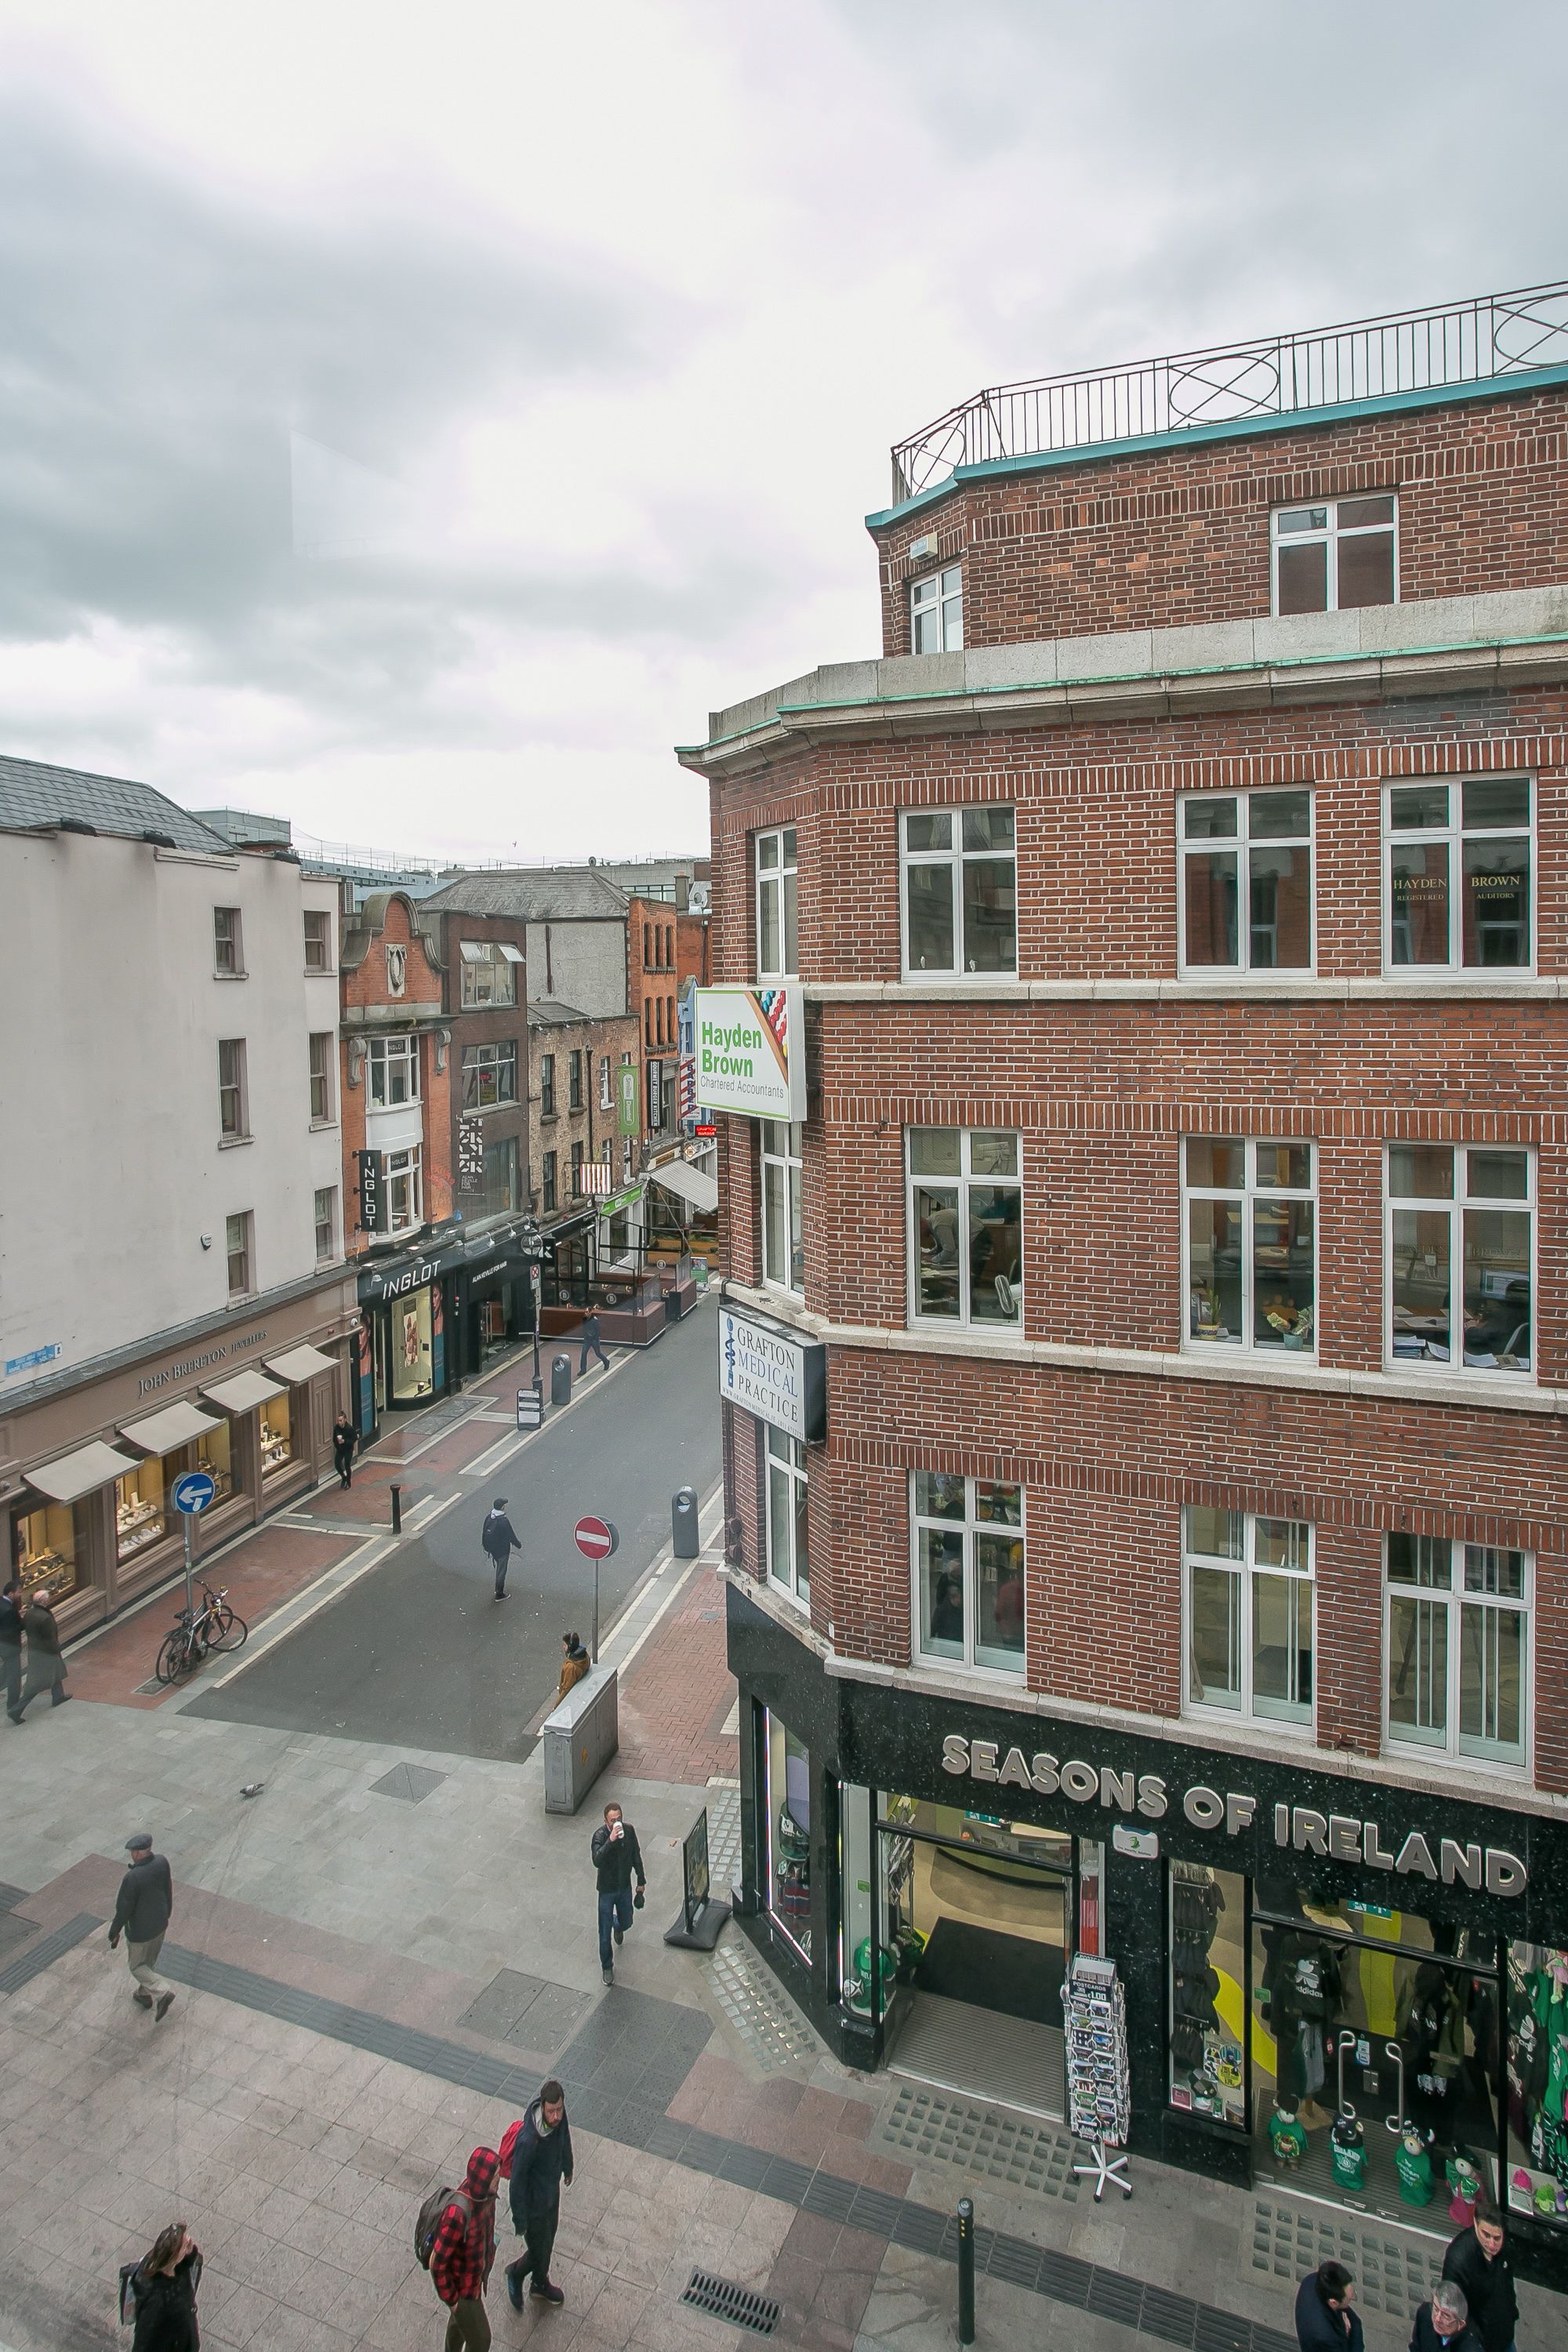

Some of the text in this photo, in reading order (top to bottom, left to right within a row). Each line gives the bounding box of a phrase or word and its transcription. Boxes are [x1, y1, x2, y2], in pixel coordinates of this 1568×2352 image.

[1394, 876, 1520, 889] HAYDEN BROWN
[702, 1021, 762, 1053] Hayden
[702, 1049, 753, 1078] Brown
[700, 1075, 784, 1098] Chartered Accountants
[365, 1156, 376, 1226] INGLOT
[383, 1259, 442, 1300] INGLOT
[139, 1330, 268, 1399] JOHN BRERETON JEWELLERS
[737, 1327, 795, 1372] GRAFTON
[738, 1348, 798, 1398] MEDICAL
[738, 1374, 798, 1423] PRACTICE
[942, 1734, 1528, 1896] SEASONS OF IRELAND
[1073, 1980, 1106, 1991] POSTCARDS
